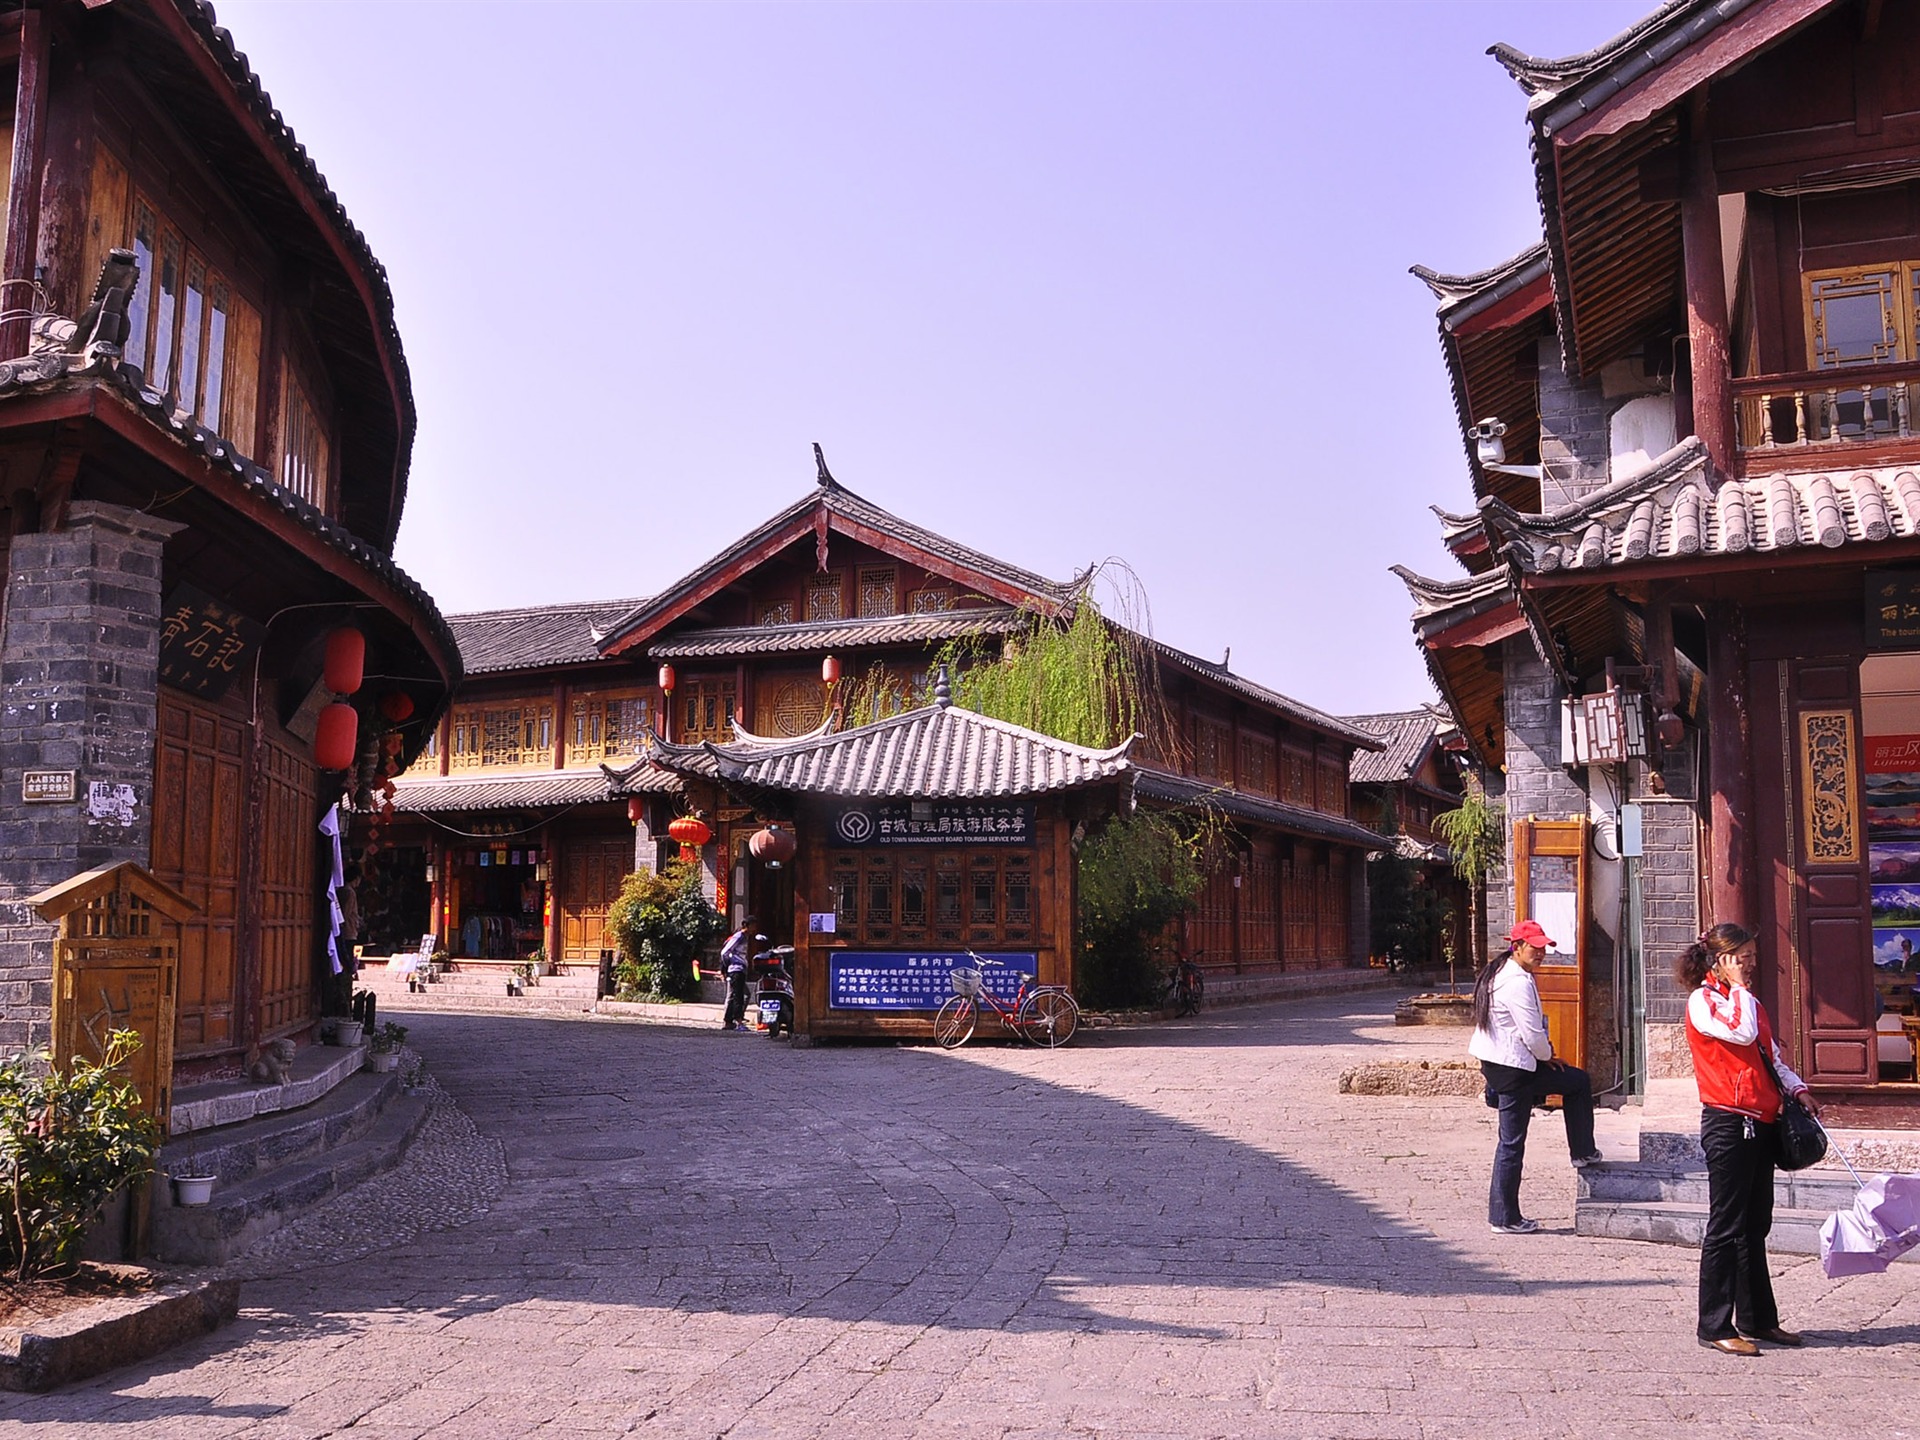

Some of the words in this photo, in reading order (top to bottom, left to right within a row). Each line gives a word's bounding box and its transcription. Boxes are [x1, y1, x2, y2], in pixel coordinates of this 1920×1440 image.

[1881, 628, 1897, 636] The
[1874, 759, 1916, 767] Lijiang
[879, 816, 1026, 833] 古城管理局旅游服务亭
[908, 957, 954, 967] 服务内容
